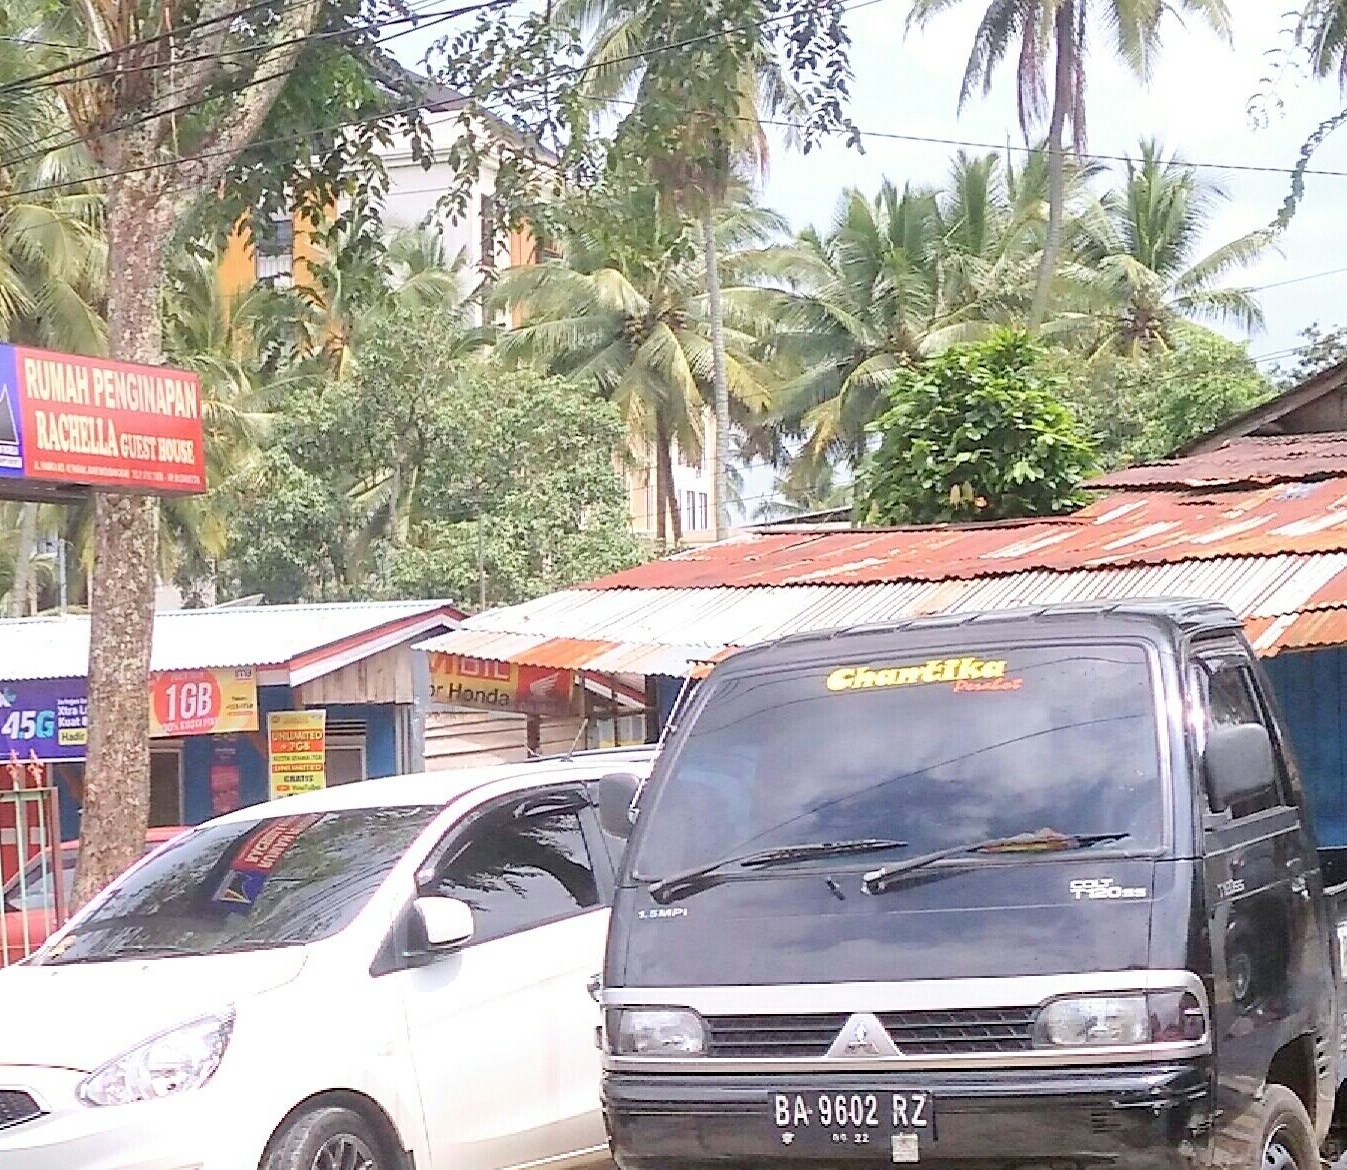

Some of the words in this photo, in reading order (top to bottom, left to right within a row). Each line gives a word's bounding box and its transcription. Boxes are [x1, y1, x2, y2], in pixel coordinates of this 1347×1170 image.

[24, 357, 89, 406] RUMAH
[92, 367, 198, 419] PENGINAPAN
[35, 410, 119, 458] RACHELLA
[120, 433, 158, 460] GUEST
[158, 436, 195, 465] HOUSE
[165, 682, 213, 721] 1GB
[449, 682, 510, 707] Honda
[1070, 877, 1114, 889] COLT
[775, 1095, 810, 1127] BA
[818, 1094, 879, 1127] 9602
[892, 1094, 928, 1127] RZ
